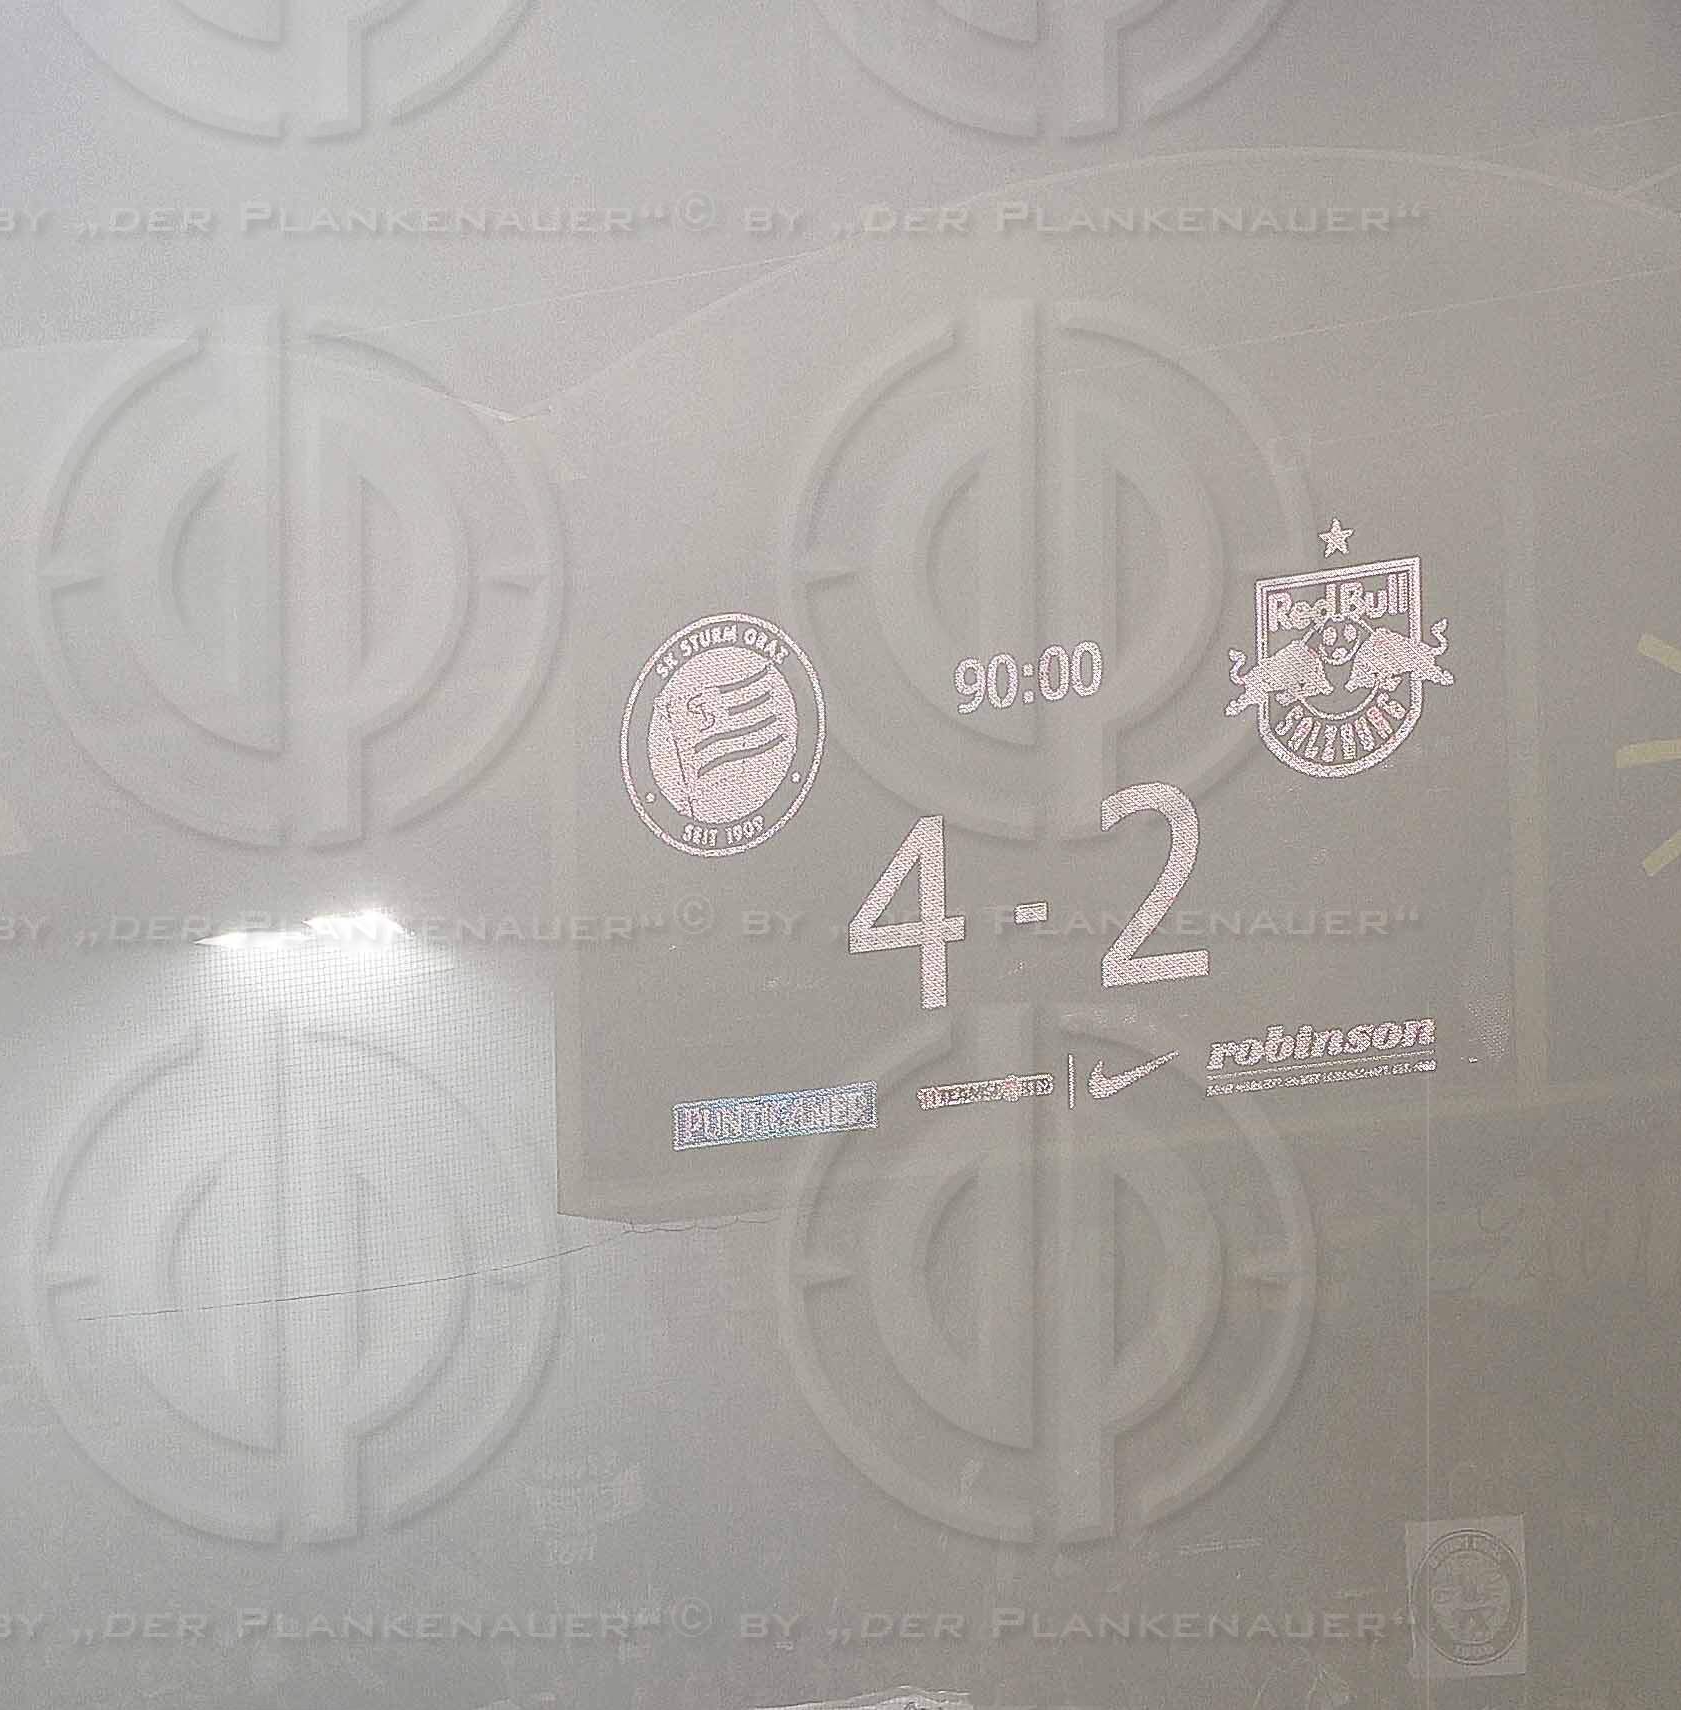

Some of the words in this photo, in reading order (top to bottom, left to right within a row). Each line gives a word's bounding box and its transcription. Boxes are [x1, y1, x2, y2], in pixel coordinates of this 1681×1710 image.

[683, 626, 737, 656] STURM
[954, 641, 1102, 713] 90:00
[1277, 693, 1405, 761] SALZBURG
[848, 815, 965, 1008] 4
[1101, 780, 1211, 989] 2
[1207, 1018, 1436, 1070] robinson
